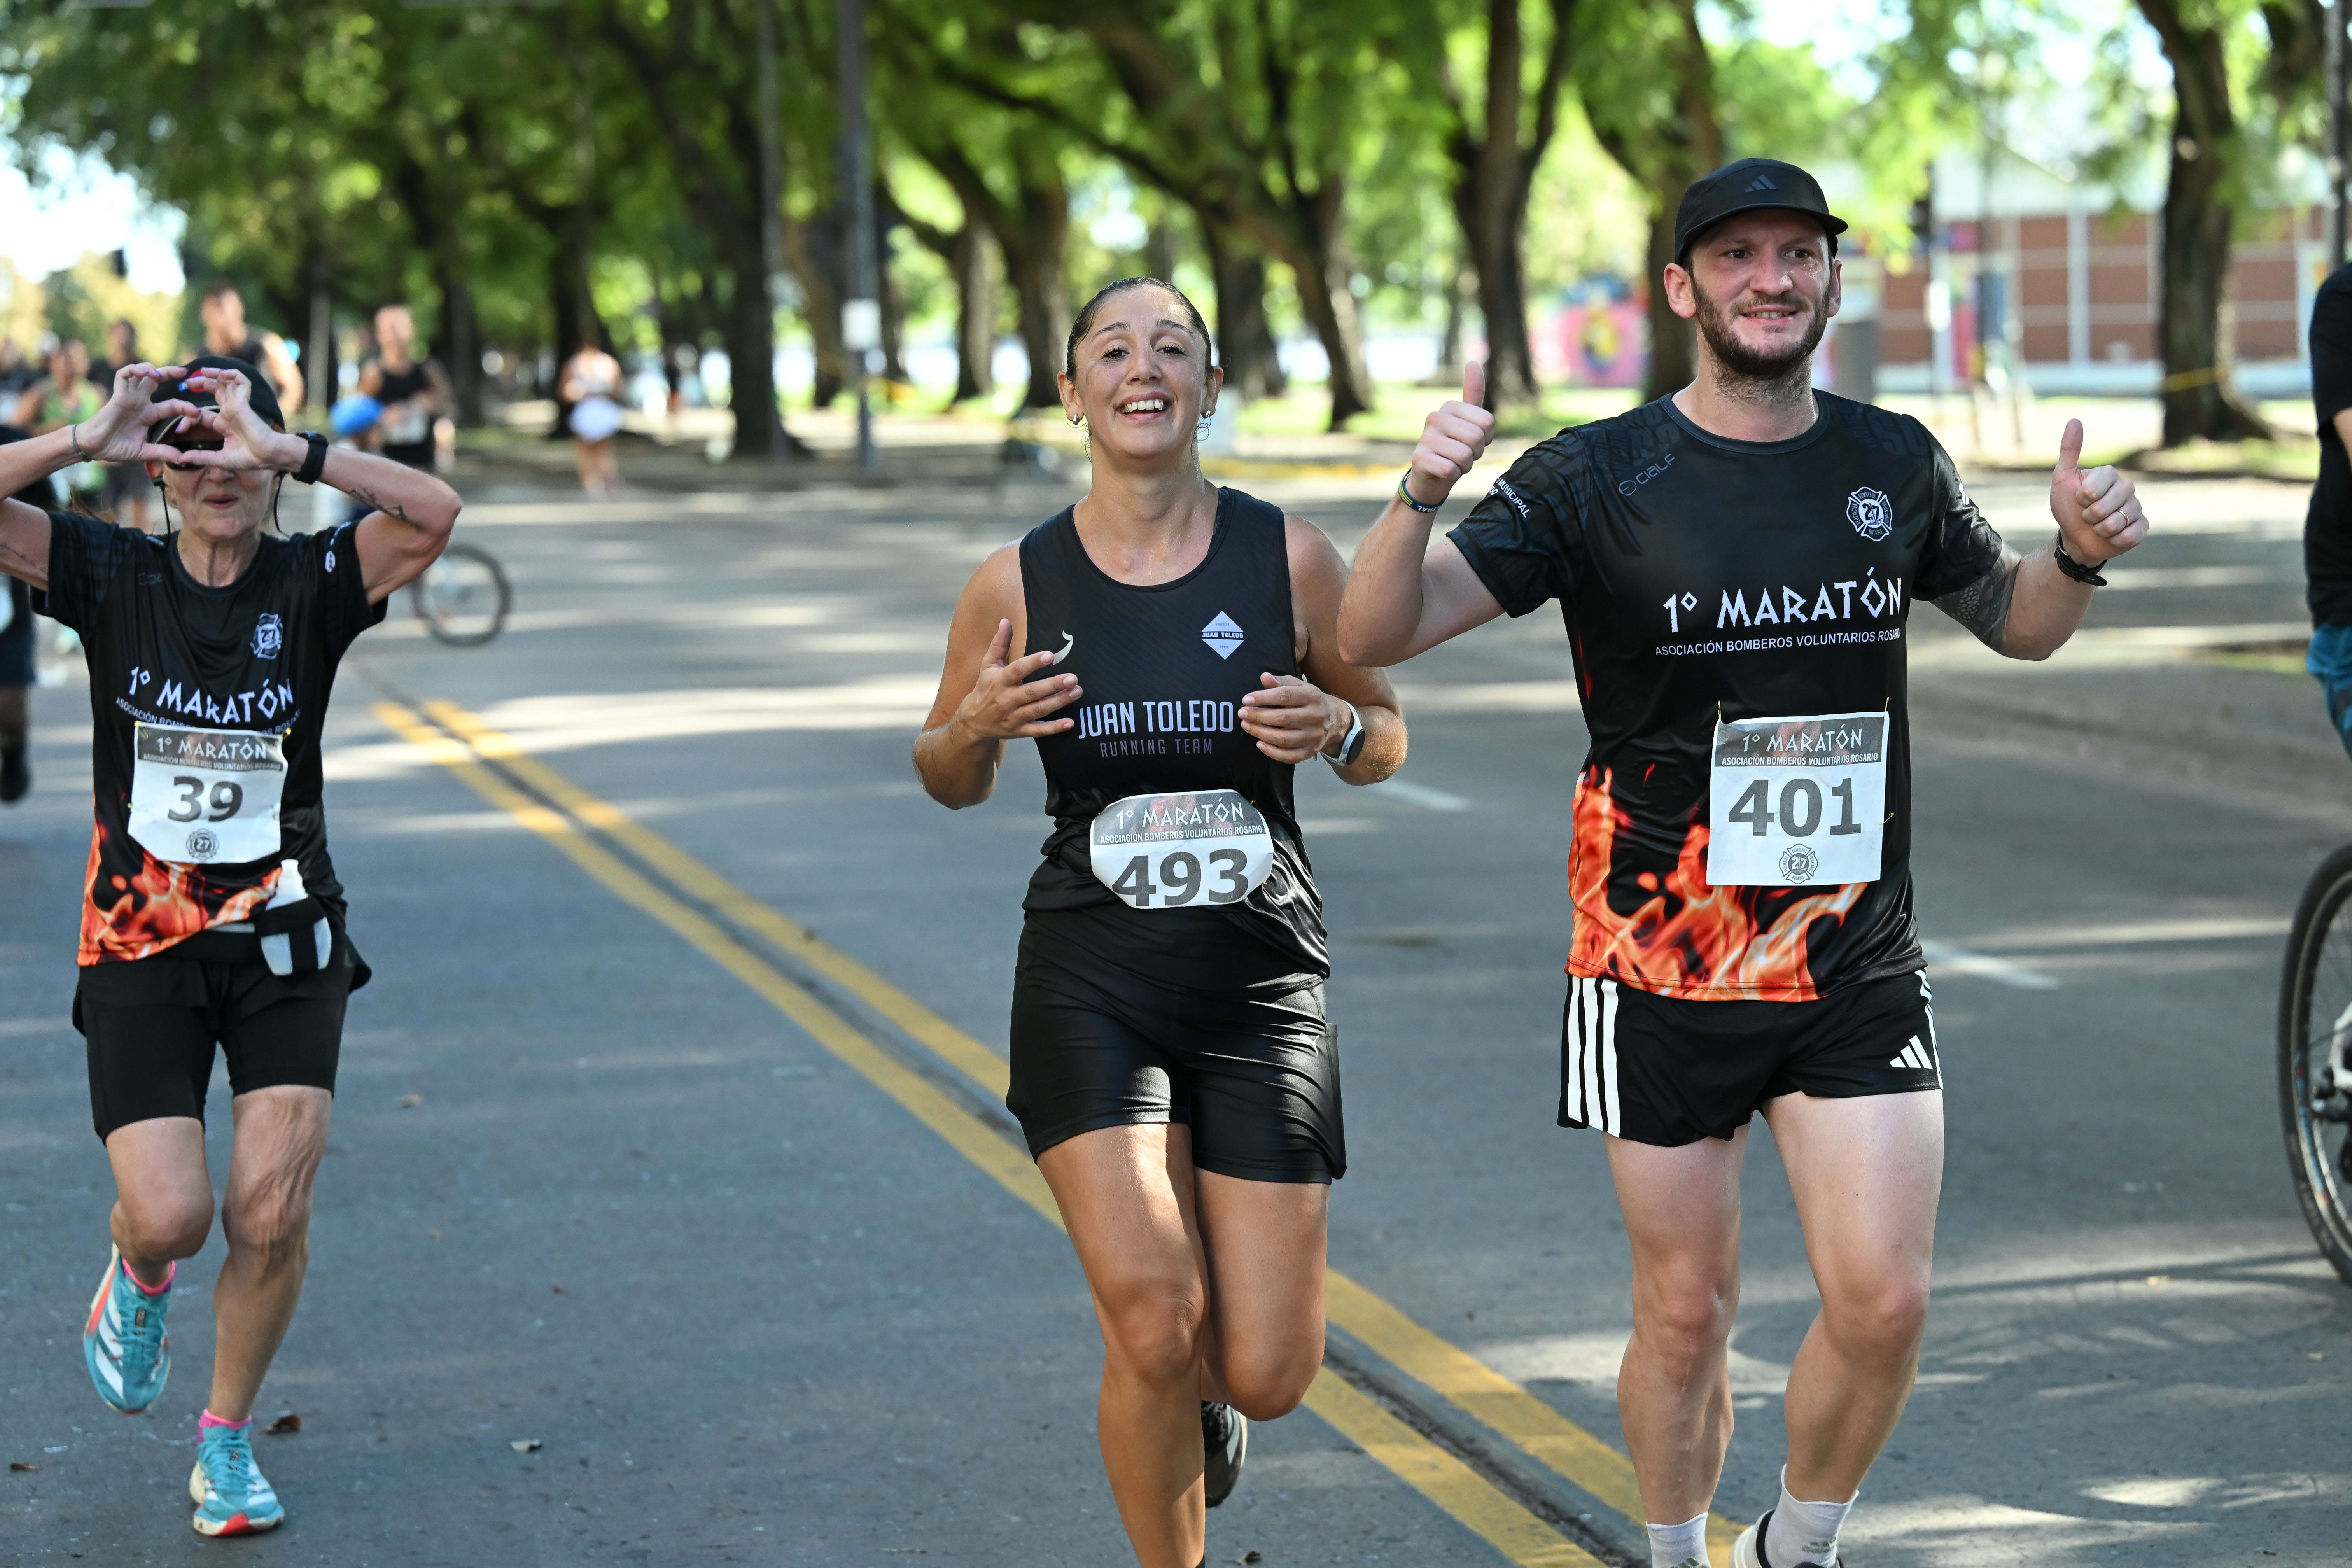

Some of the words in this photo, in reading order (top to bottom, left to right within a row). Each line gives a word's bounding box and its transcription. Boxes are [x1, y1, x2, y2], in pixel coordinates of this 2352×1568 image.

[1498, 479, 1530, 518] MUNICIPAL
[1862, 503, 1880, 521] 27
[1717, 566, 1902, 629] MARATÓN
[1655, 640, 1723, 656] ASOCIACIÓN
[1727, 636, 1793, 652] BOMBEROS
[1796, 631, 1876, 647] VOLUNTARIOS
[1878, 627, 1900, 642] ROSARIO
[117, 696, 158, 724] ASOCIACIÓN
[156, 678, 294, 724] MARATÓN
[1078, 702, 1136, 739] JUAN
[1142, 700, 1234, 733] TOLEDO
[178, 738, 266, 760] MARATÓN
[1099, 739, 1166, 758] RUNNING
[1174, 738, 1212, 754] TEAM
[1766, 723, 1863, 752] MARATÓN
[1721, 756, 1765, 765] ASOCIACIÓN
[1767, 756, 1807, 765] BOMBEROS
[1808, 754, 1850, 765] VOLUNTARIOS
[1851, 752, 1879, 763] ROSARIO
[168, 775, 243, 822] 39
[1142, 796, 1244, 828] MARATÓN
[1729, 778, 1861, 837] 401
[196, 838, 210, 850] 27
[1100, 831, 1143, 844] ASOCIACIÓN
[1144, 830, 1184, 841] BOMBEROS
[1185, 827, 1233, 838] VOLUNTARIOS
[1234, 825, 1263, 835] ROSARIO
[1111, 848, 1249, 906] 493
[1792, 856, 1807, 870] 27
